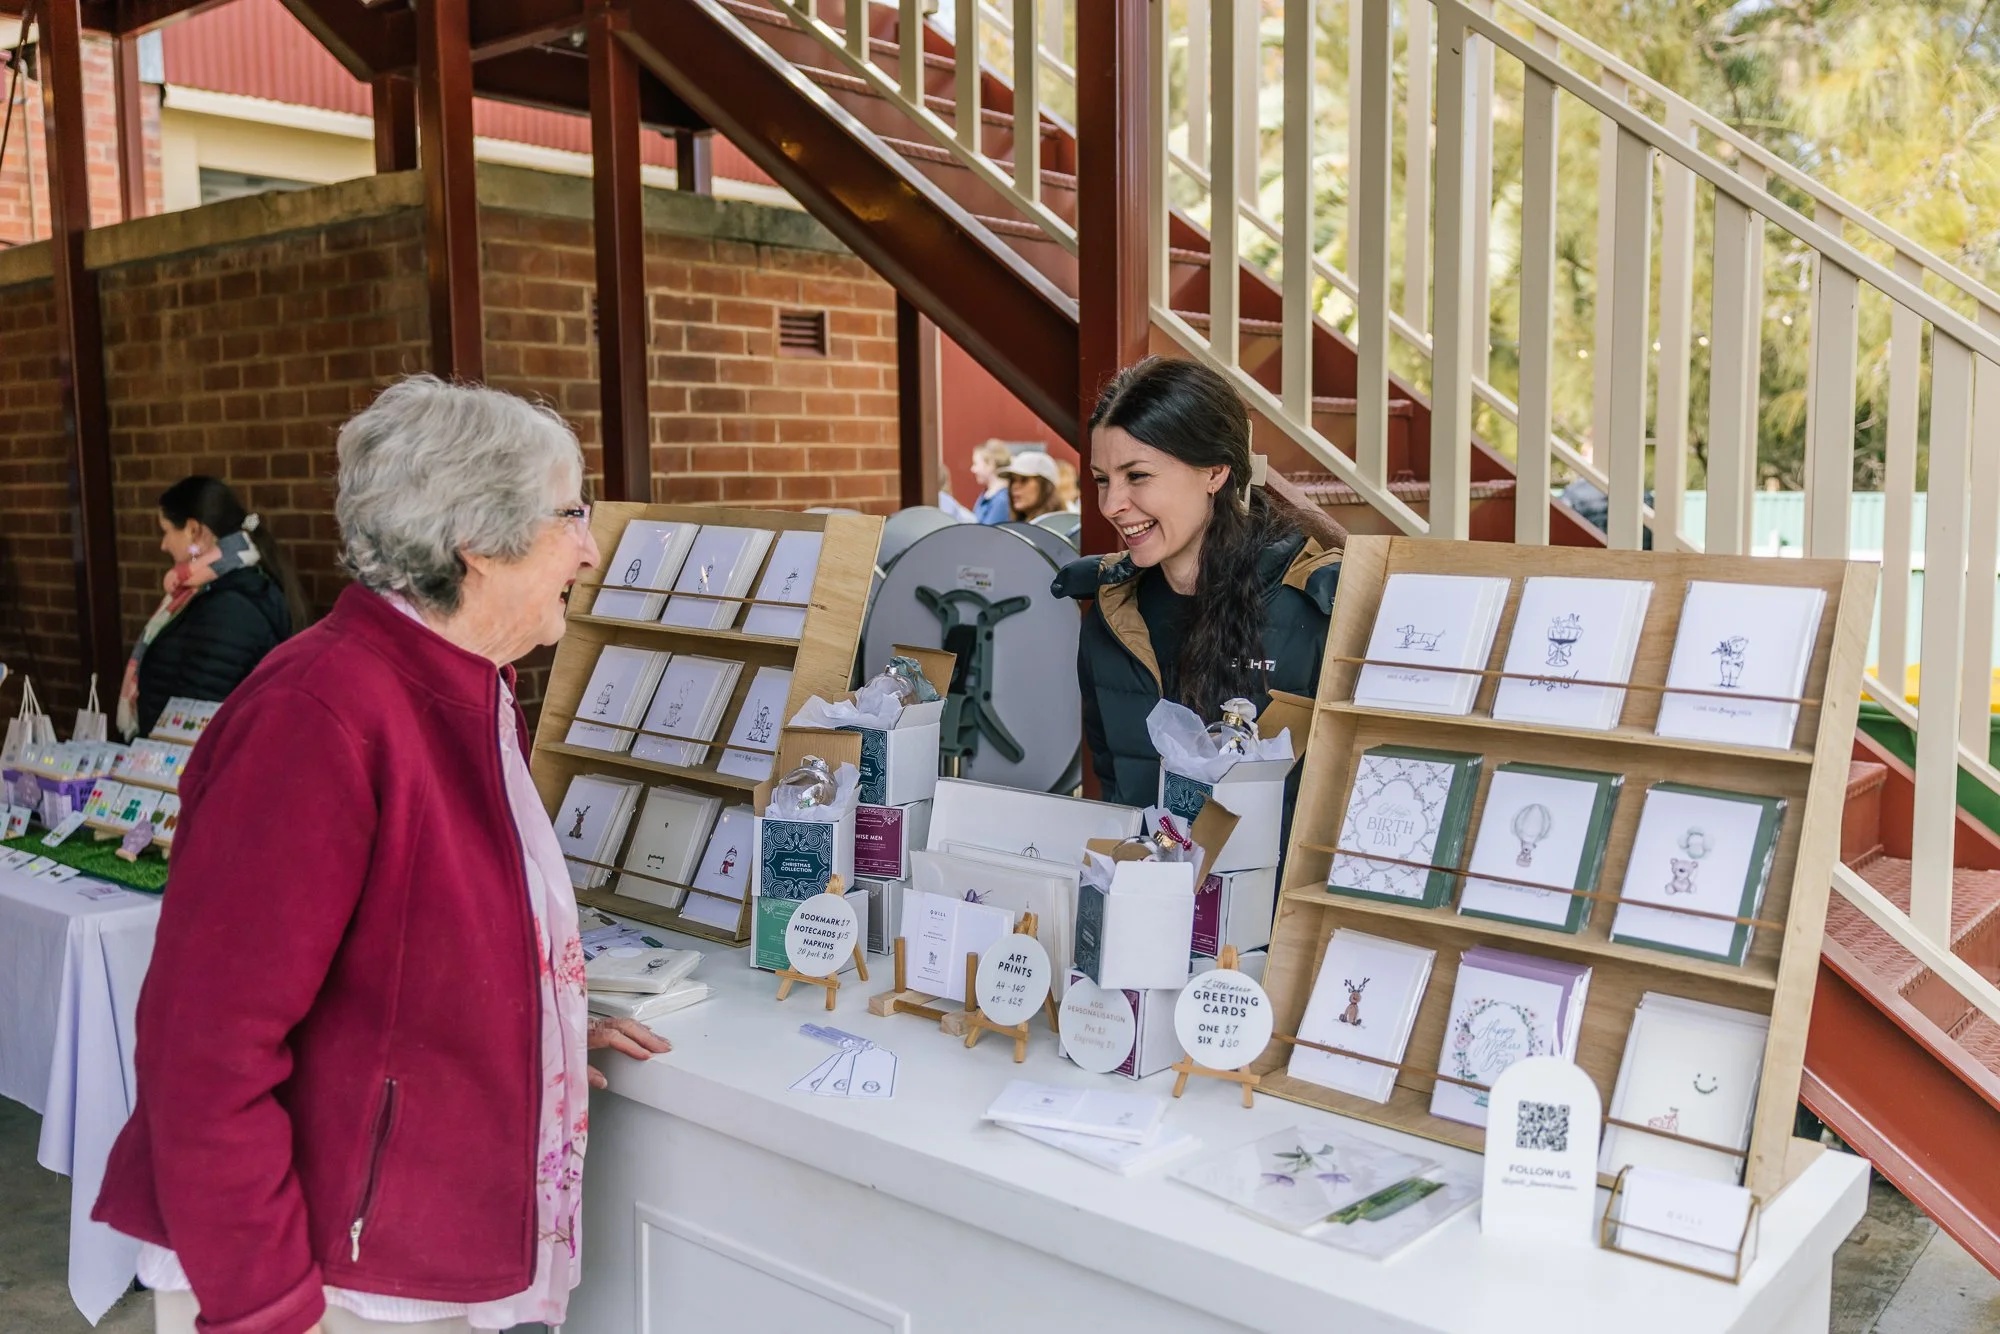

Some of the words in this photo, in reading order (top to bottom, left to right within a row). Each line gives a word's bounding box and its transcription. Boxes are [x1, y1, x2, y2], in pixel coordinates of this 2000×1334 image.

[1366, 816, 1414, 835] BIRTH
[1373, 831, 1397, 847] DAY
[800, 912, 840, 926] BOOKMARK
[794, 925, 836, 938] NOTECARDS
[836, 931, 851, 940] $15
[803, 939, 834, 950] NAPKINS
[822, 951, 835, 960] $10
[1008, 953, 1028, 964] ART
[998, 961, 1032, 978] PRINTS
[1090, 1001, 1104, 1009] ADD
[1193, 990, 1259, 1007] GREETING
[1067, 1005, 1126, 1023] PERSONALISATION
[1203, 1003, 1246, 1018] CARDS
[1198, 1023, 1220, 1034] ONE
[1225, 1024, 1239, 1035] $7
[1197, 1035, 1213, 1045] SIX
[1219, 1038, 1240, 1048] $30
[1509, 1164, 1554, 1177] FOLLOW
[1557, 1170, 1571, 1179] US
